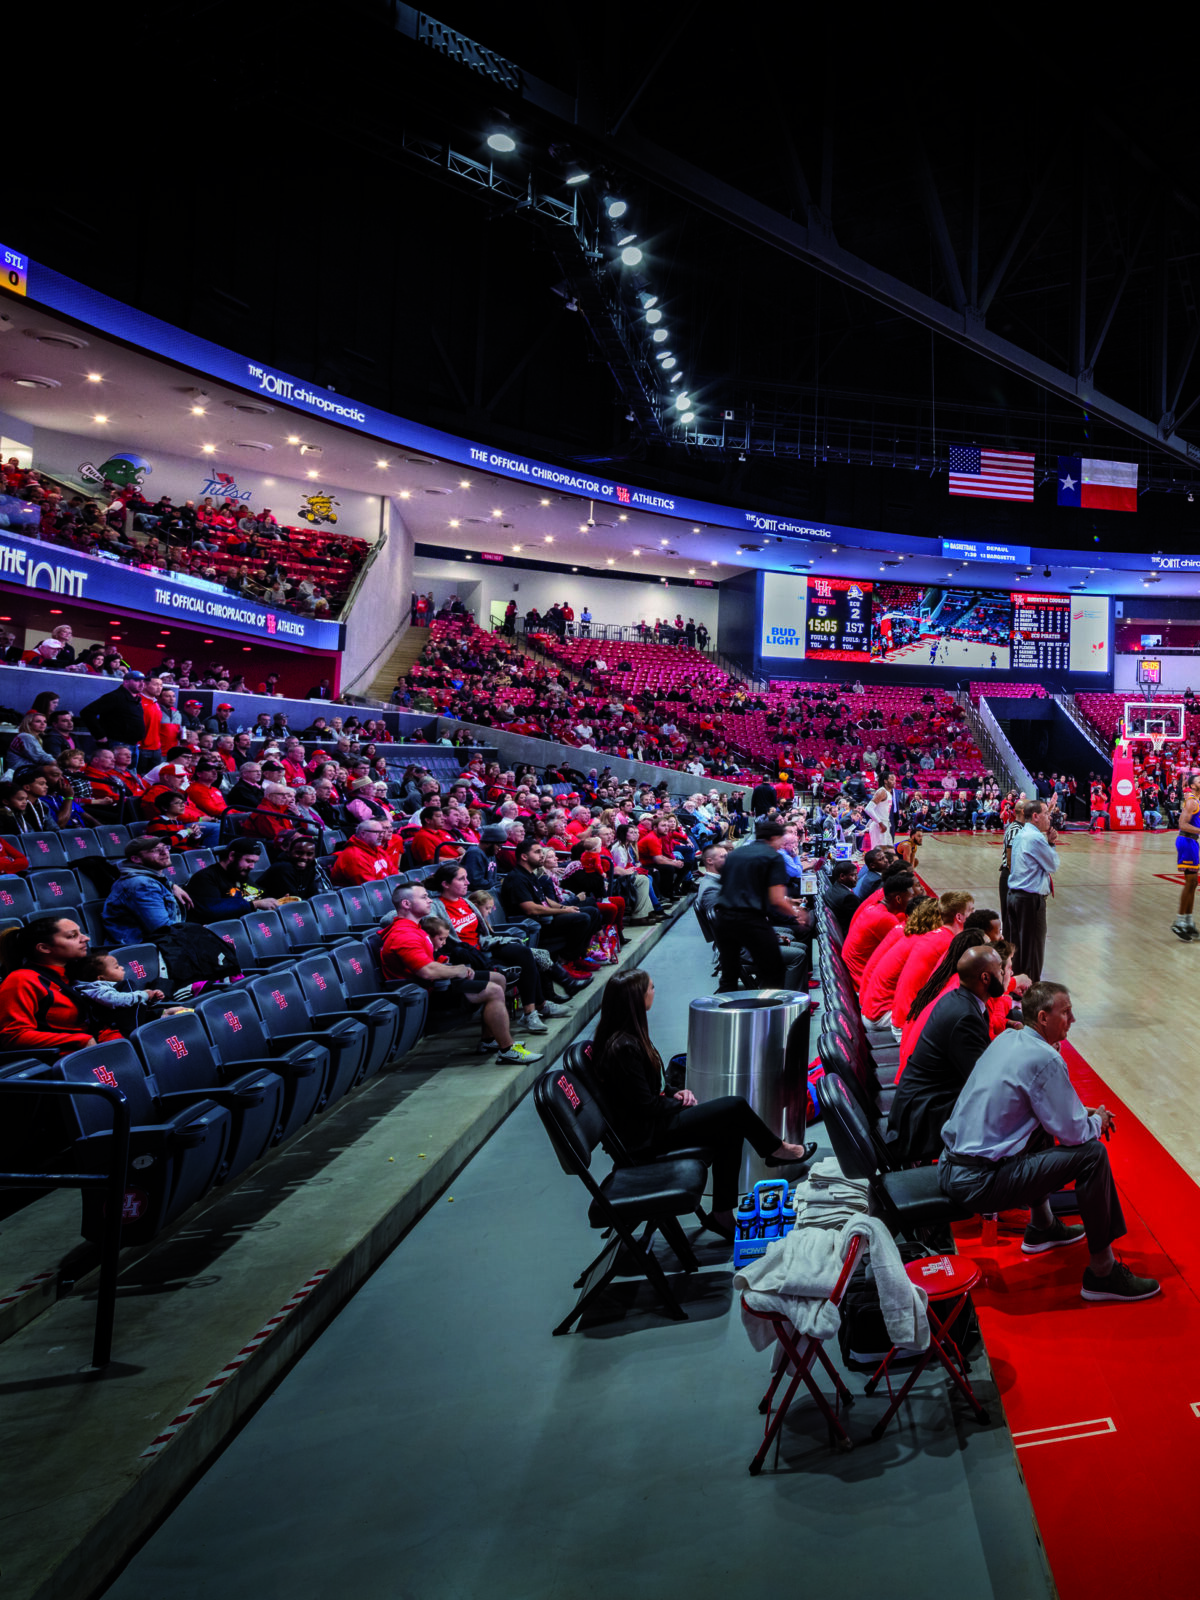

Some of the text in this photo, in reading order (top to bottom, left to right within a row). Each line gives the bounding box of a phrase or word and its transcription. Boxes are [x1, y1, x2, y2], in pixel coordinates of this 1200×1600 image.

[4, 251, 24, 270] STL
[8, 270, 20, 286] 0
[248, 364, 263, 379] THE
[294, 388, 365, 423] chiropractic
[470, 448, 488, 462] THE
[490, 455, 530, 475] OFFICIAL
[531, 466, 599, 492] CHIROPRACTOR
[601, 485, 614, 496] OF
[632, 492, 675, 510] ATHLETICS
[200, 479, 252, 501] Tulsa
[778, 522, 831, 538] chiropractic
[815, 580, 832, 597] UH
[155, 588, 171, 605] THE
[172, 593, 205, 613] OFFICIAL
[206, 602, 256, 625] CHIROPRACTOR
[256, 614, 266, 627] OF
[277, 619, 304, 636] ATHLETICS
[817, 606, 827, 616] 5
[851, 609, 860, 619] 2
[771, 627, 796, 637] BUD
[808, 618, 838, 632] 15:05
[846, 622, 864, 633] 1ST
[766, 636, 800, 646] LIGHT
[1115, 805, 1136, 826] UH
